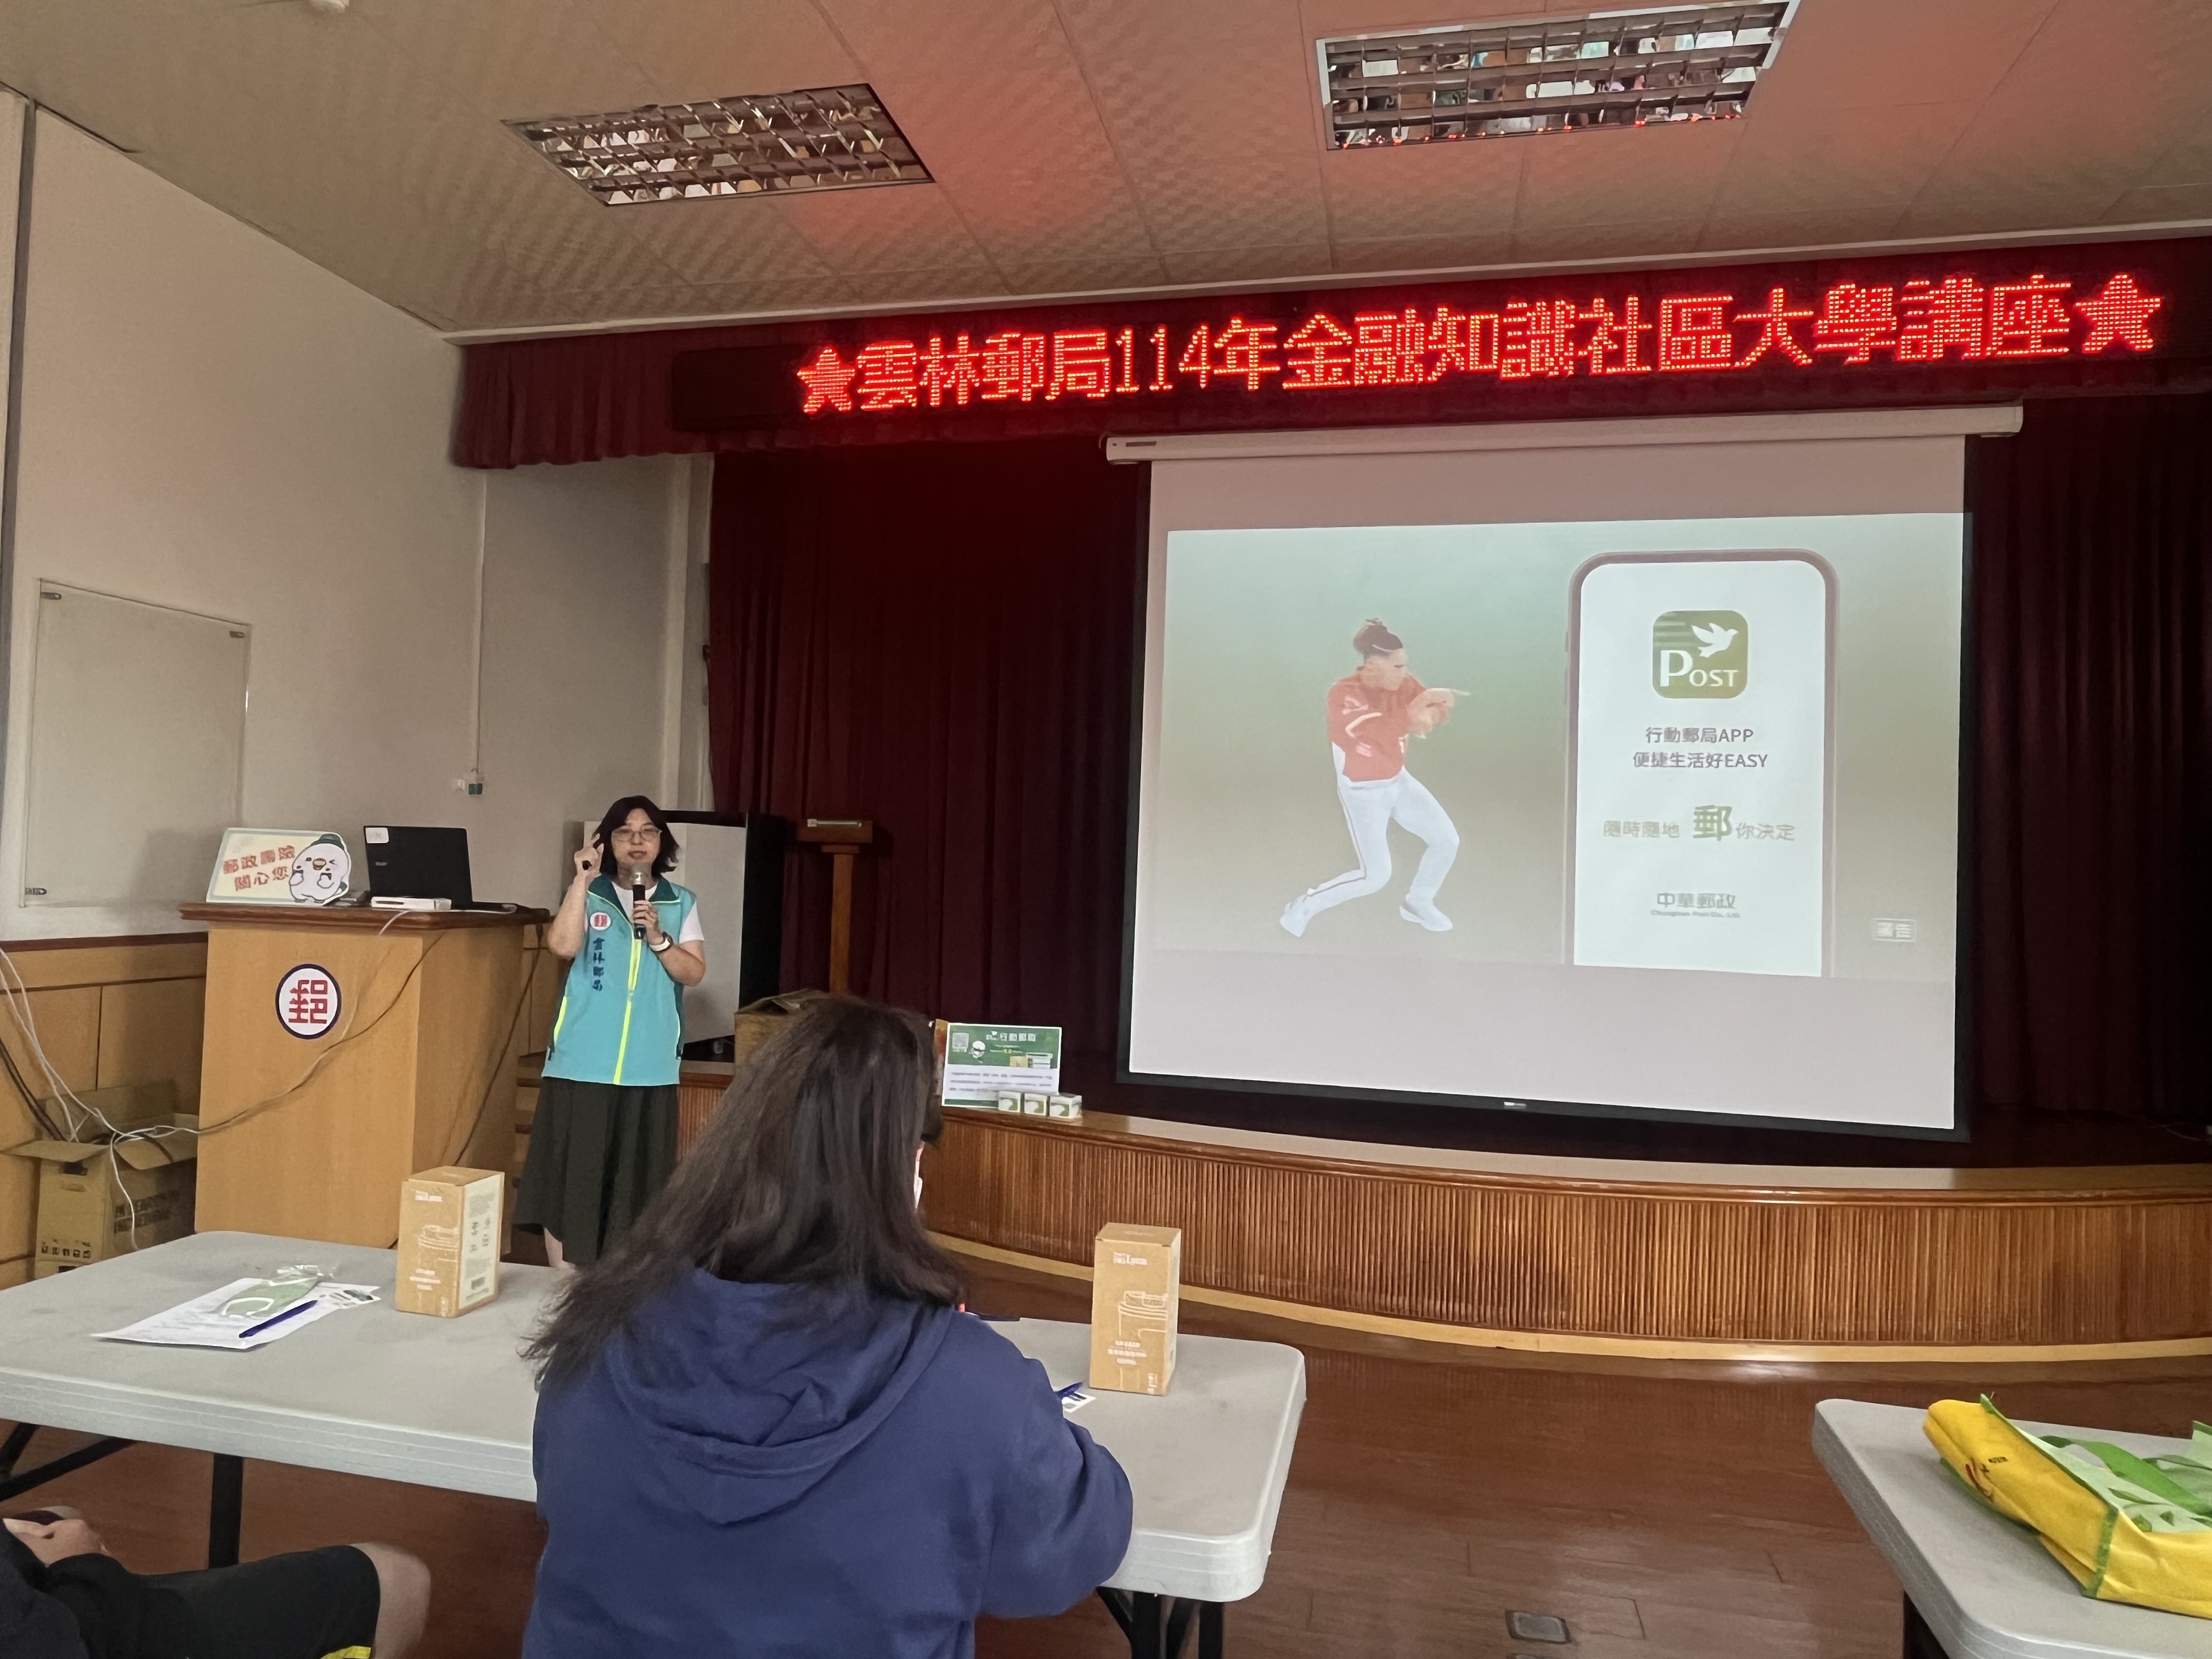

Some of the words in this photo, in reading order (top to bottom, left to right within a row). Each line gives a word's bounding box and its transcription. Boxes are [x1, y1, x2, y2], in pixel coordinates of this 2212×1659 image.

[854, 274, 2072, 411] 雲林郵局114年金融知識社區大學講座
[1645, 726, 1754, 745] 行動郵局APP
[1632, 751, 1768, 769] 便捷生活好EASY
